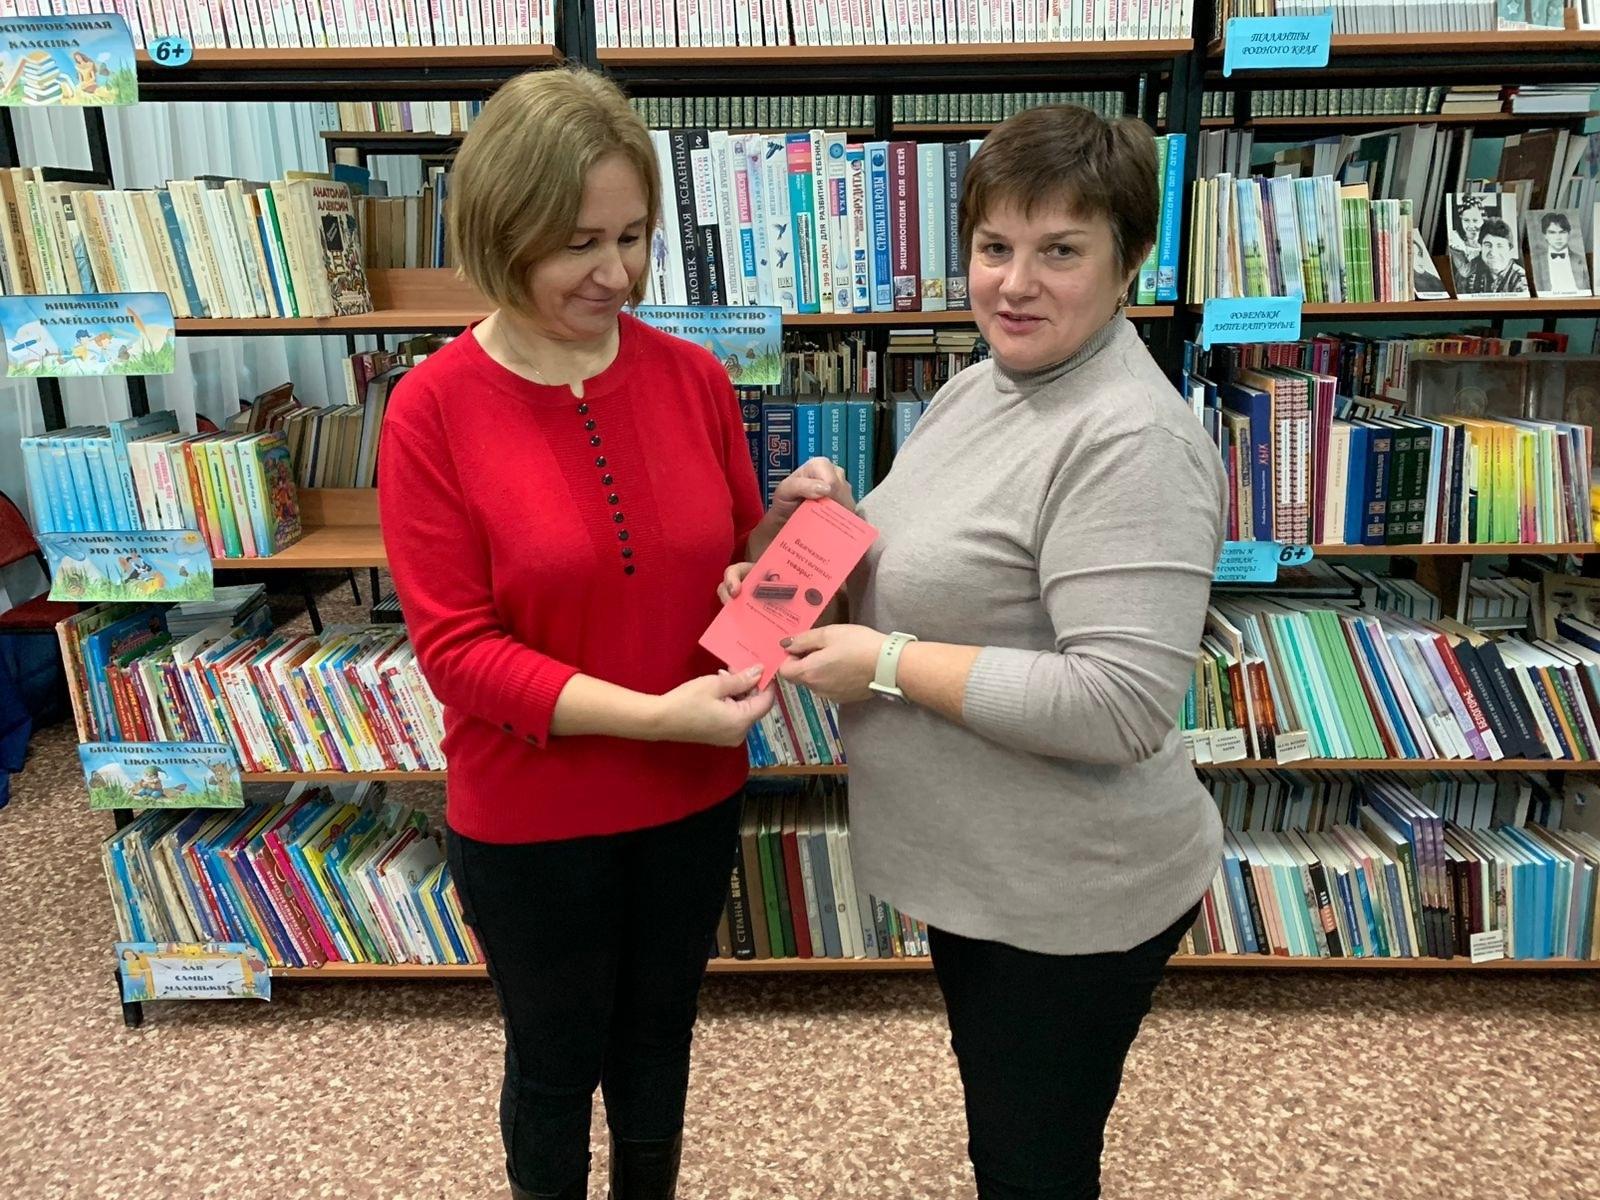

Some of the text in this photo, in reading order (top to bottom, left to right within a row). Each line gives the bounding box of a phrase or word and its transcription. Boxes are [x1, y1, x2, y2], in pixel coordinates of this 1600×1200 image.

[0, 21, 112, 33] СТРИРОВАННАЯ
[9, 39, 80, 49] КЛАССИКА
[1251, 32, 1310, 42] ТАЛАНТЫ
[156, 41, 185, 60] 6+
[1242, 44, 1319, 55] РОДНОГО КРАЯ
[674, 134, 690, 206] ВСЕЛЕННАЯ
[925, 150, 934, 177] ДЕТЕЙ
[312, 186, 349, 199] АНАТОЛИЙ
[817, 179, 826, 220] РАЗВИТИЯ
[852, 171, 864, 215] ЭРУДИТА
[874, 176, 886, 210] НАРОДЫ
[1163, 139, 1178, 261] ЭНЦИКЛОПЕДИЯ ДЛЯ ДЕТЕЙ
[317, 201, 348, 211] АЛЕКСИН
[896, 147, 907, 270] ЭНЦИКЛОПЕДИЯ ДЛЯ ДЕТЕЙ
[949, 150, 958, 272] ЭНЦИКЛОПЕДИЯ ДЛЯ ДЕТЕЙ
[683, 212, 696, 251] ЗЕМЛЯ
[820, 223, 828, 240] ДЛЯ
[876, 219, 887, 250] СТРАНЫ
[927, 202, 936, 271] ЭНЦИКЛОПЕДИЯ
[45, 301, 119, 311] КНИЖНЫЙ
[39, 314, 135, 327] КАЛЕЙДОСКОП
[632, 310, 705, 320] ПРАВОЧНОЕ
[710, 311, 766, 320] ЦАРСТВО
[1229, 310, 1281, 320] РОВЕНЬКИ
[683, 326, 766, 335] ГОСУДАРСТВО
[1210, 320, 1295, 331] ЛИТЕРАТУРНЫЕ
[859, 408, 867, 434] ДЕТЕЙ
[70, 535, 120, 545] УЛЫБКА
[125, 535, 133, 543] И
[137, 534, 168, 543] СМЕХ
[89, 546, 169, 555] ЭТО ДЛЯ ВСЕХ
[794, 538, 830, 564] Внимание!
[1279, 545, 1306, 562] 6+
[780, 541, 832, 580] Некачественные
[786, 559, 814, 580] товары!
[1464, 688, 1488, 731] БЕЛОГОРЬЕ
[89, 745, 227, 755] БИБЛИОТЕКА МЛАДШЕГО
[124, 757, 199, 767] ШКОЛЬНИКА
[730, 866, 746, 943] СТРАНЫ МИРА
[182, 964, 204, 973] ДЛЯ
[175, 974, 214, 982] САМЫХ
[165, 984, 233, 993] МАЛЕНЬКИХ
